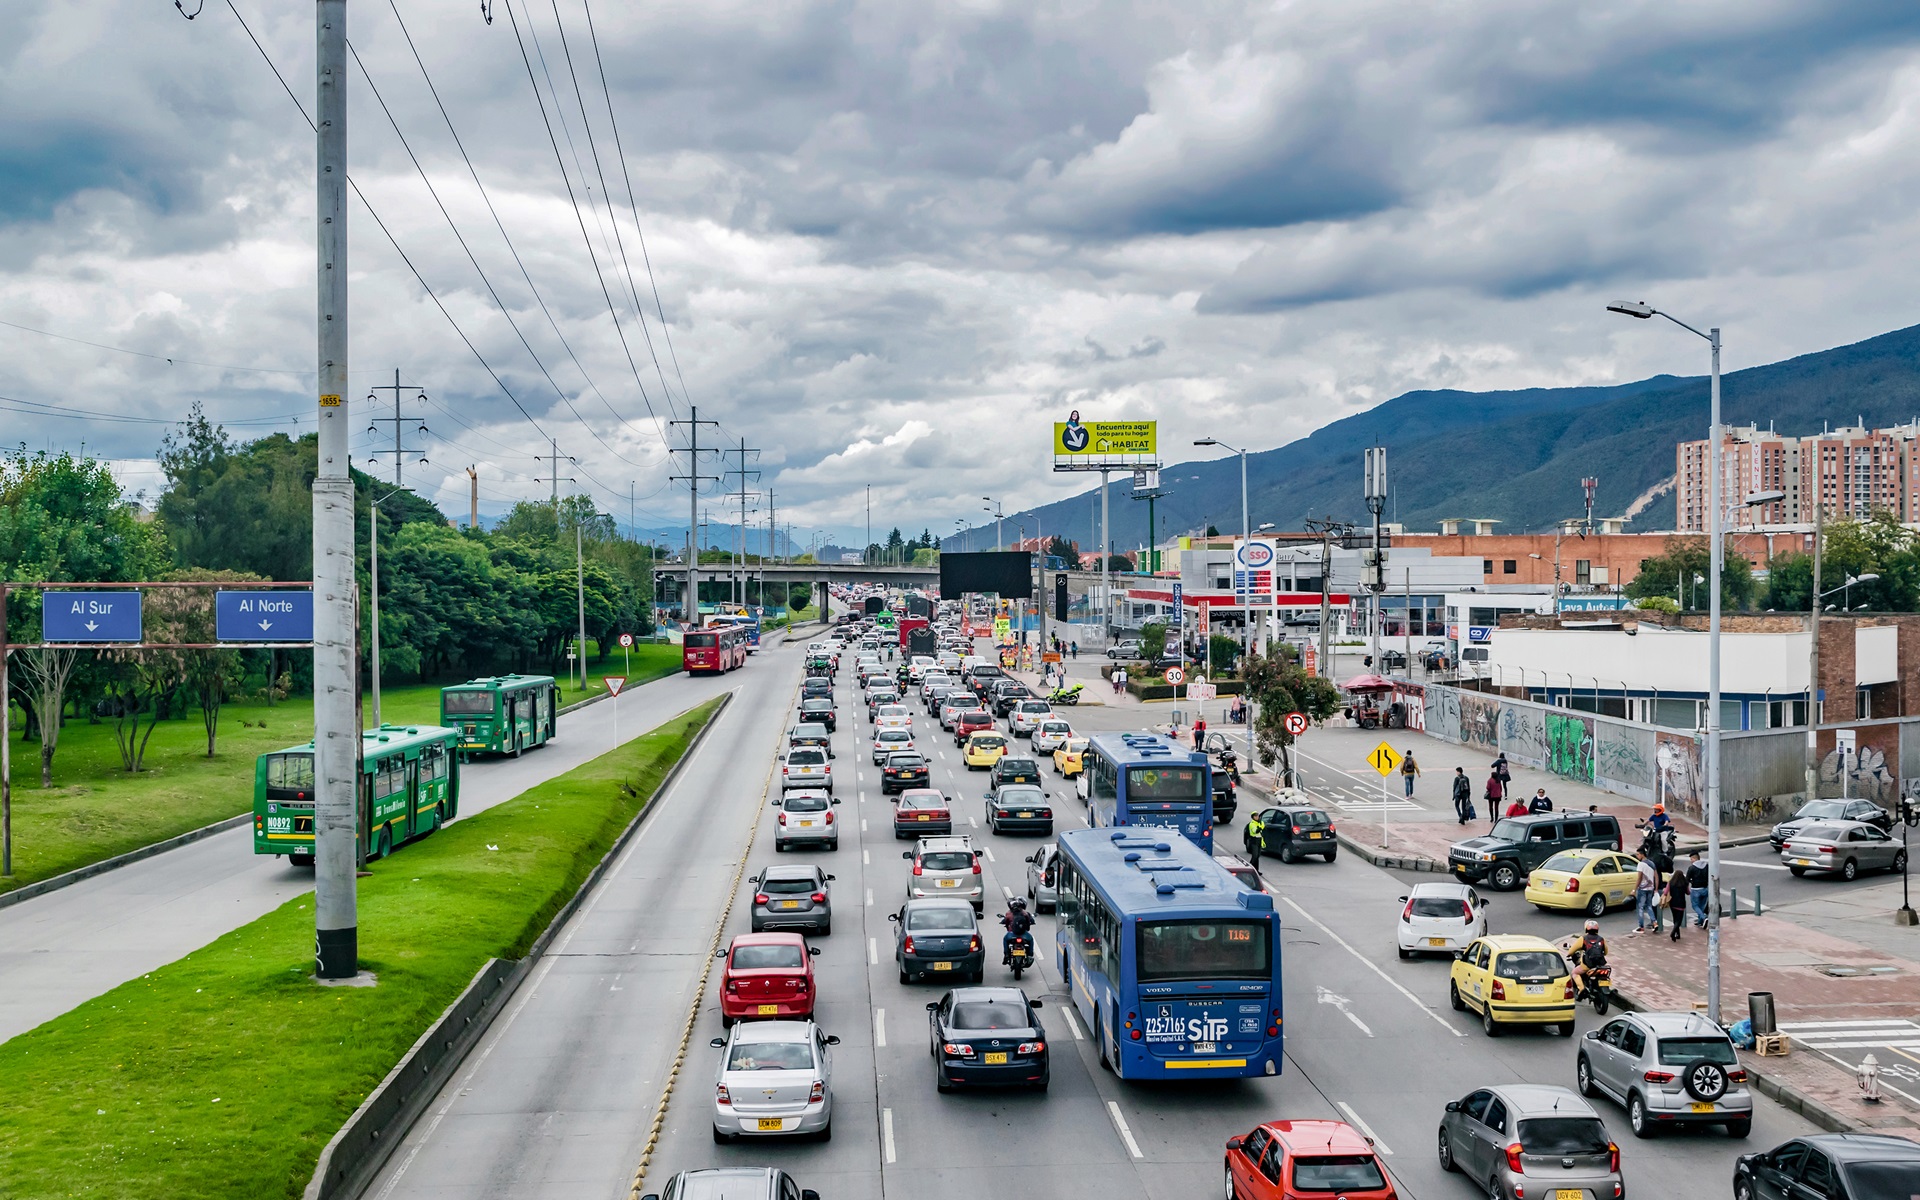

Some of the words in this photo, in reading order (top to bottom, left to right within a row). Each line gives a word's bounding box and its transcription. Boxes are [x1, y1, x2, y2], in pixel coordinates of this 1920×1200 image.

[322, 397, 338, 405] 1655
[1112, 440, 1150, 448] HABITAT
[1244, 550, 1269, 560] SSO
[70, 601, 85, 615] Al
[88, 601, 113, 616] Sur
[238, 599, 254, 613] Al
[258, 599, 293, 613] Norte
[1558, 601, 1583, 612] Lava
[1585, 601, 1616, 612] Autos
[1168, 671, 1182, 681] 30
[1228, 929, 1251, 941] T163
[1570, 1191, 1582, 1199] 602
